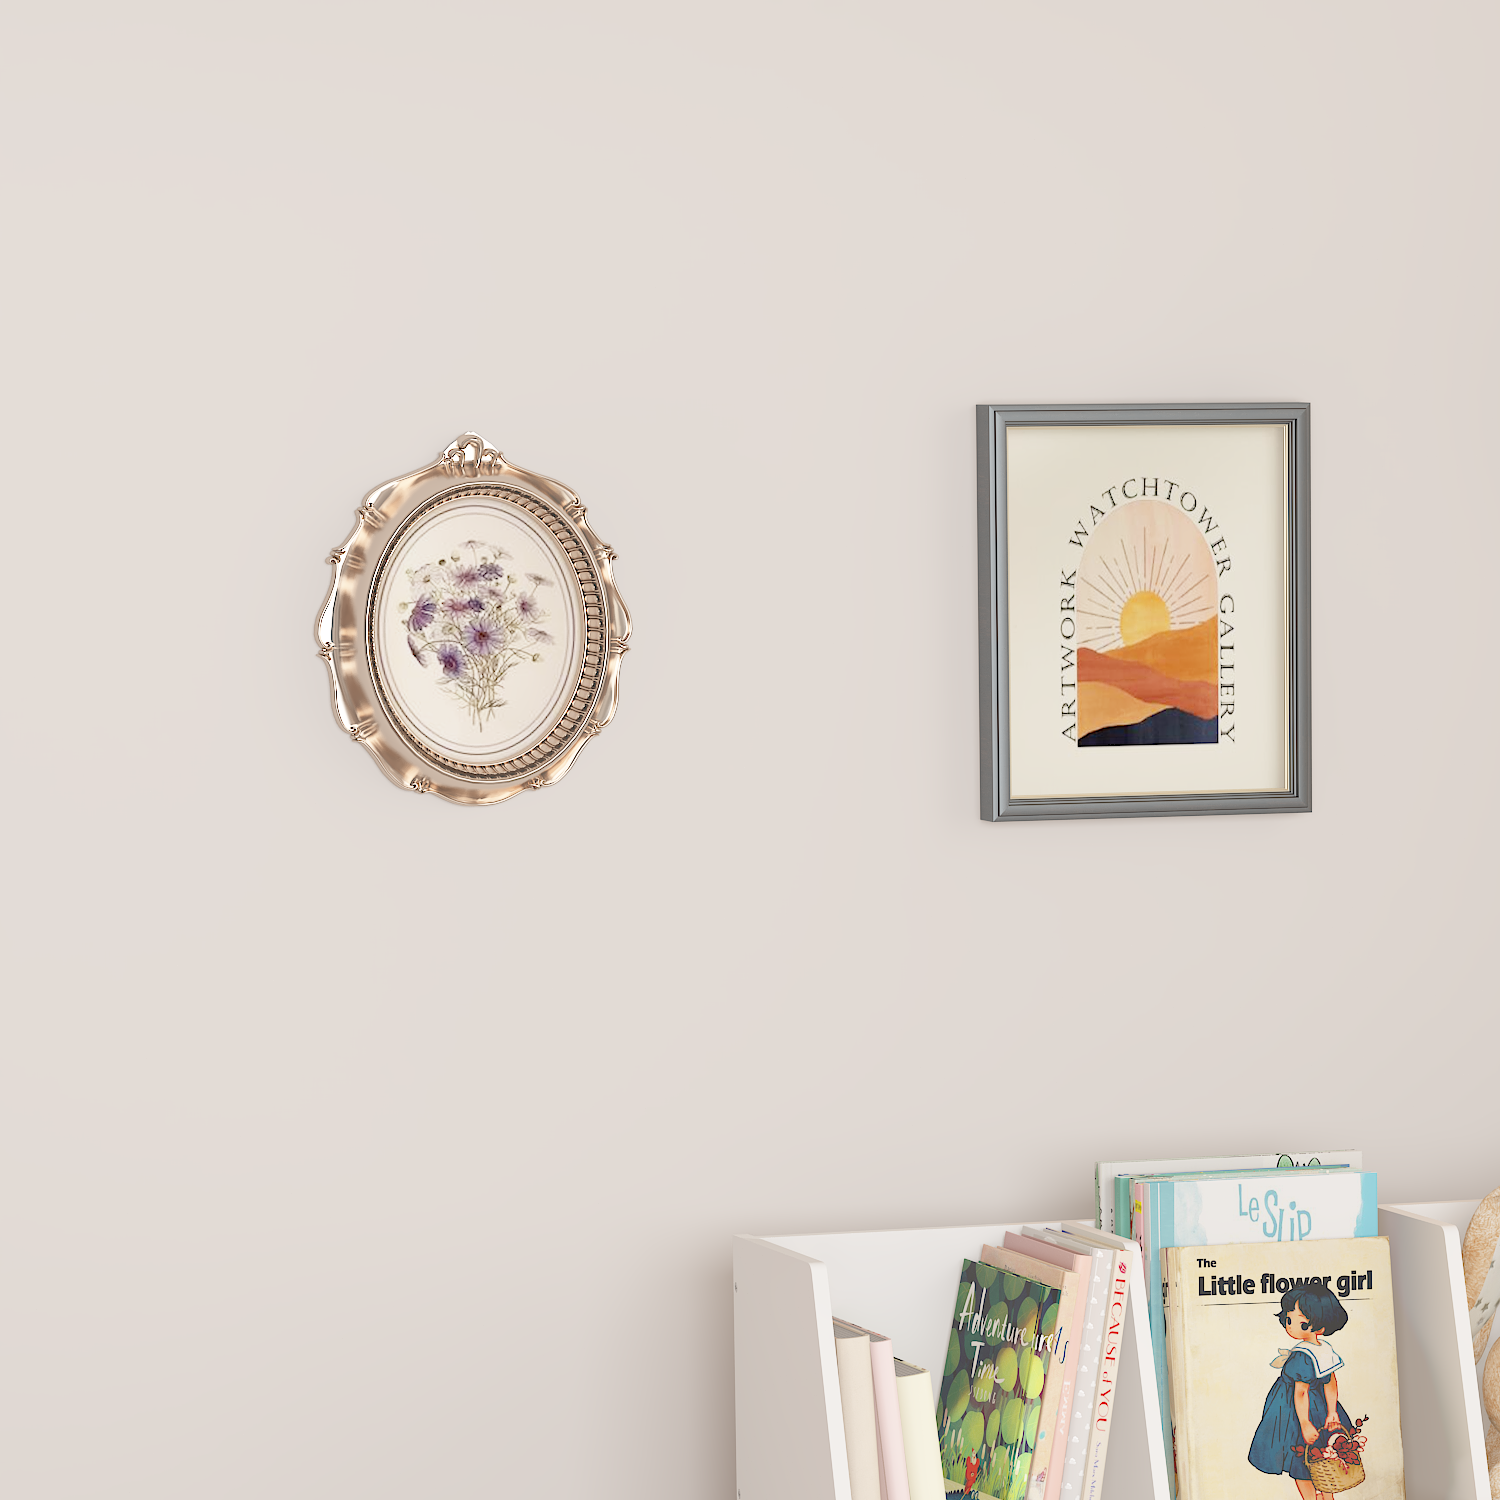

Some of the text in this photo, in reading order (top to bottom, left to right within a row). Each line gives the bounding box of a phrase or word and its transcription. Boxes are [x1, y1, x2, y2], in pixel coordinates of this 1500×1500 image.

[1060, 476, 1237, 744] ARTWORK WATCHTOWER GALLERY
[1238, 1183, 1260, 1223] Le
[1196, 1258, 1217, 1268] The
[1198, 1274, 1256, 1297] Little
[1336, 1269, 1373, 1298] girl
[958, 1280, 1029, 1347] Adventure
[1103, 1278, 1126, 1367] BECAUSE
[970, 1340, 1006, 1384] Time
[1095, 1388, 1112, 1432] YOU
